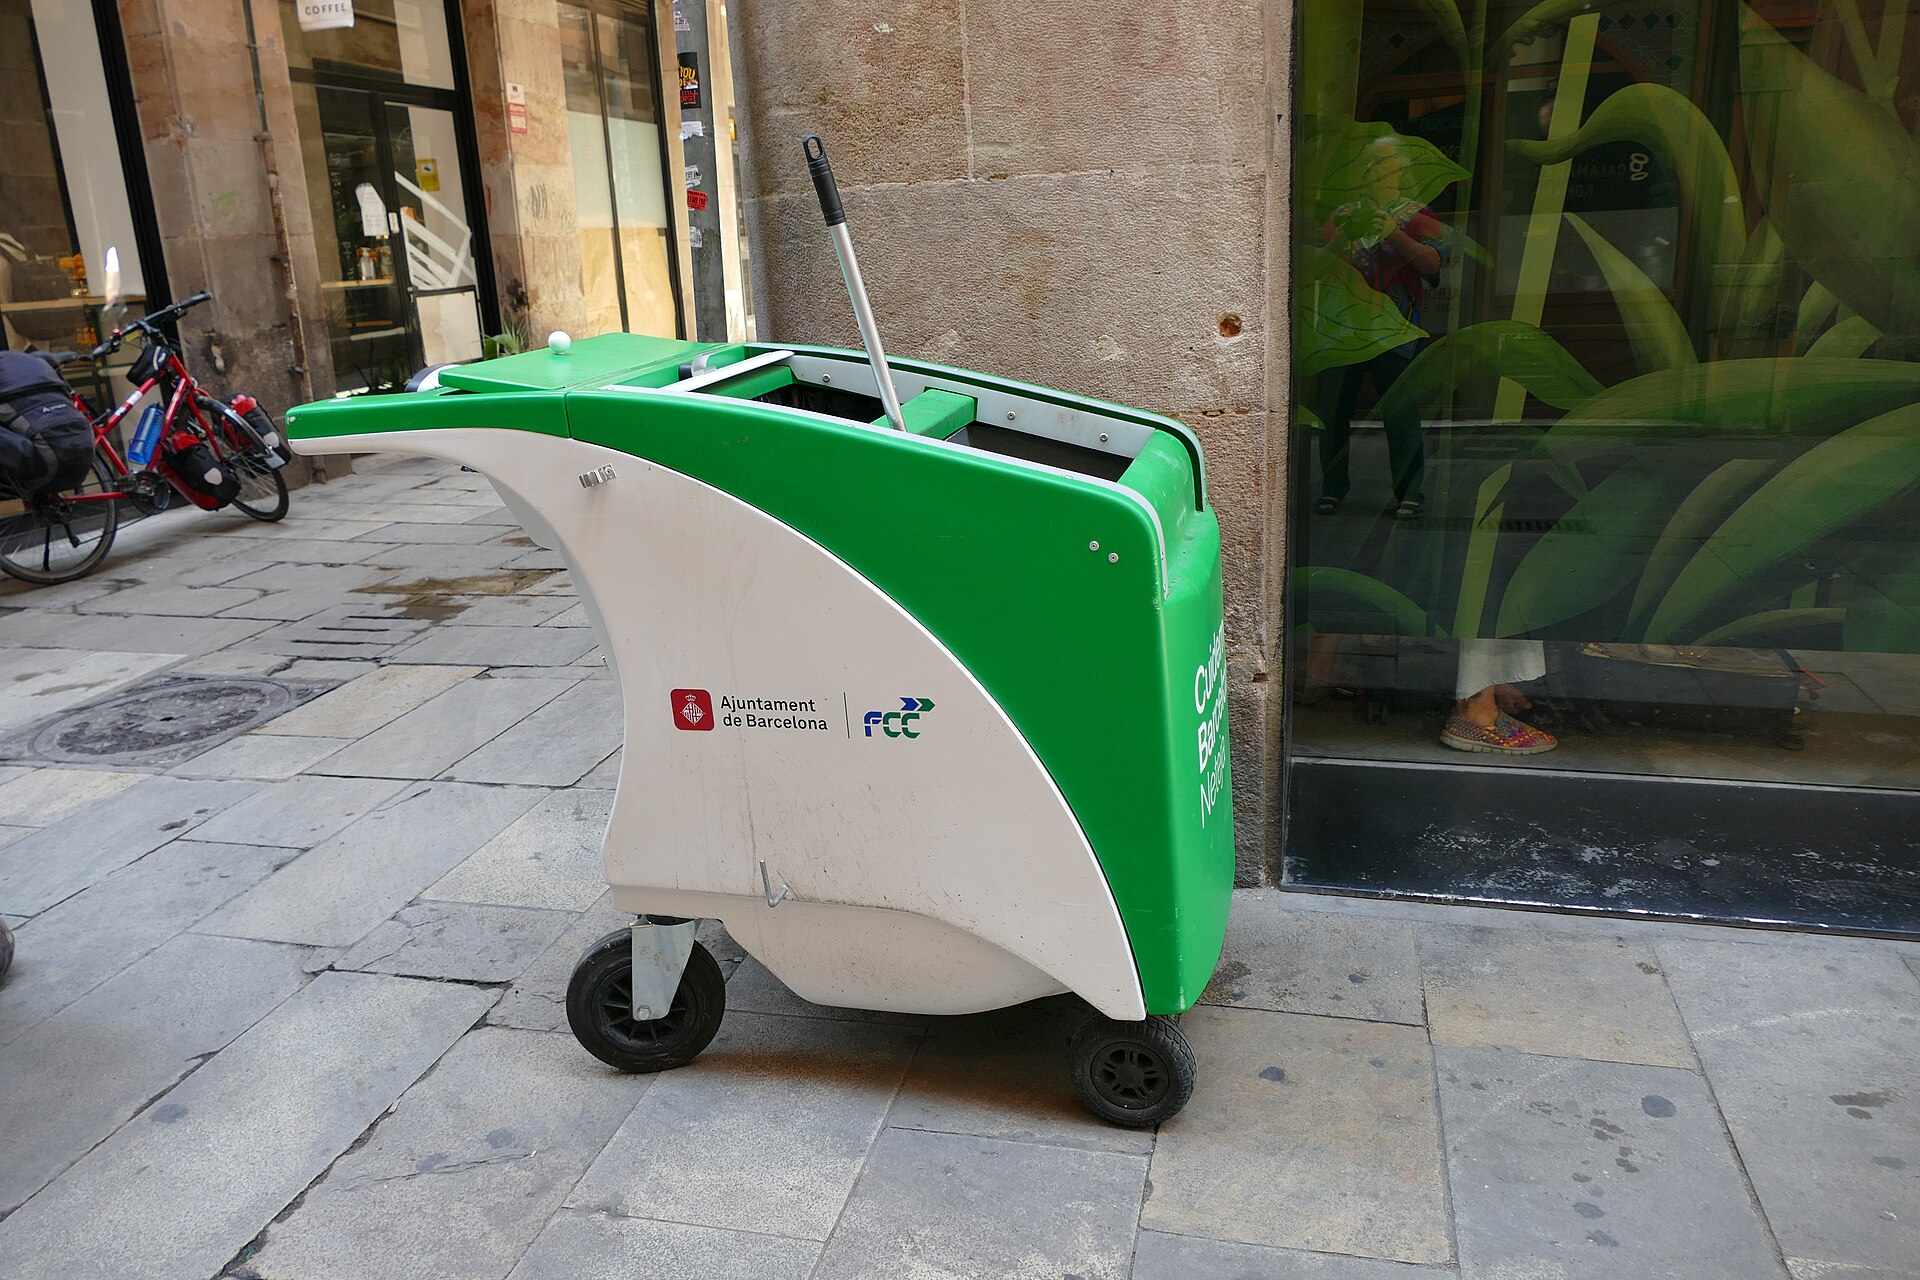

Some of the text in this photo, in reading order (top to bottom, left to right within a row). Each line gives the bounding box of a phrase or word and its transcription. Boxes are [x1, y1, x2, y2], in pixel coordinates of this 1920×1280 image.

[304, 2, 346, 15] COFFEE
[720, 695, 816, 714] Ajuntament
[723, 713, 829, 731] de Barcelona
[863, 711, 921, 739] FCC
